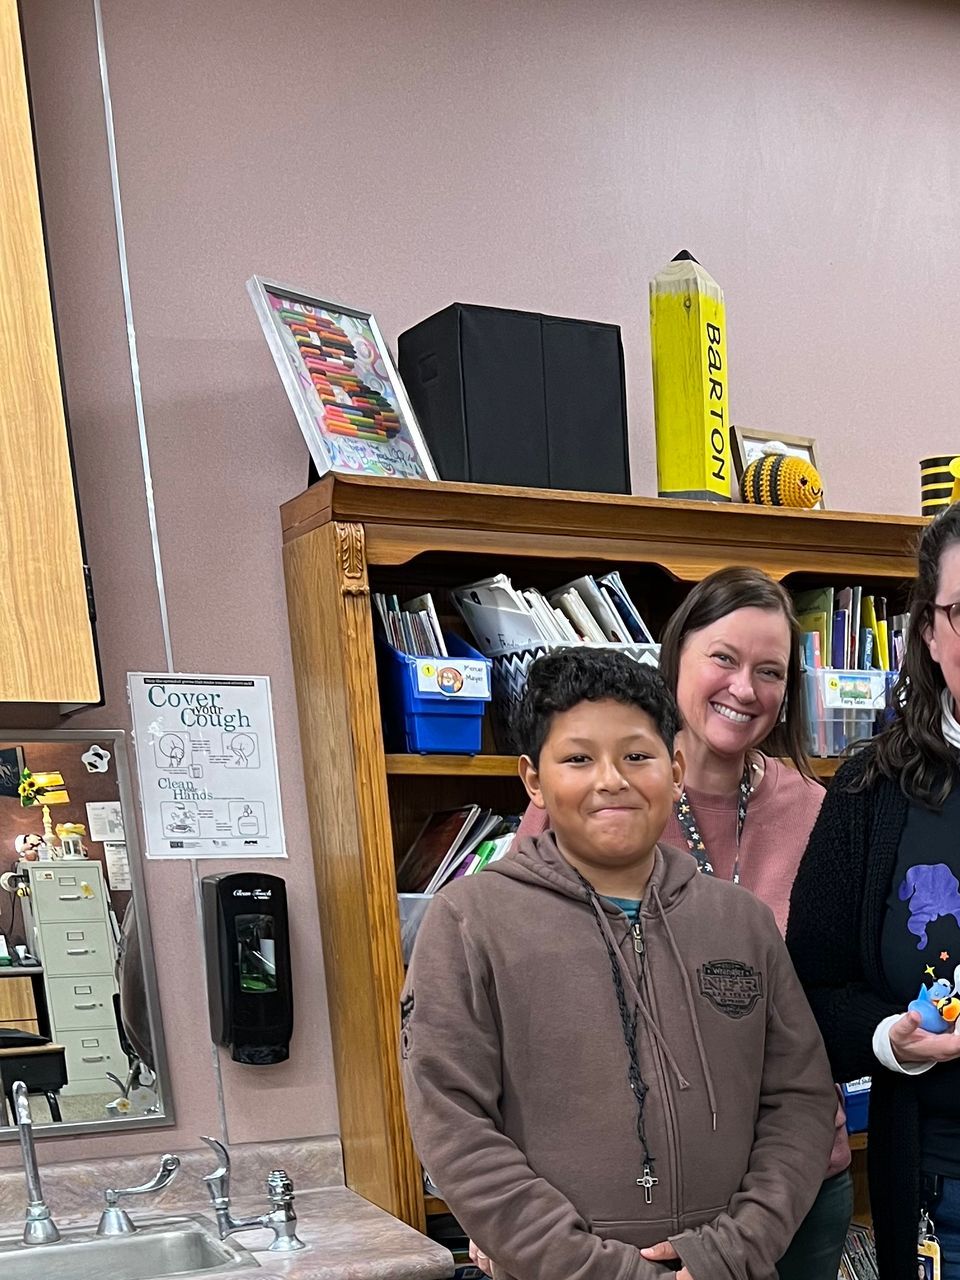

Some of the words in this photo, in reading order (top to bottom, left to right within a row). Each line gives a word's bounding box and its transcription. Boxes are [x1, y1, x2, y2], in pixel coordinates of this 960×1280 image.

[148, 685, 221, 708] Cover
[193, 705, 223, 716] your
[181, 708, 251, 732] Cough
[157, 777, 194, 790] Clean
[173, 788, 214, 801] Hands
